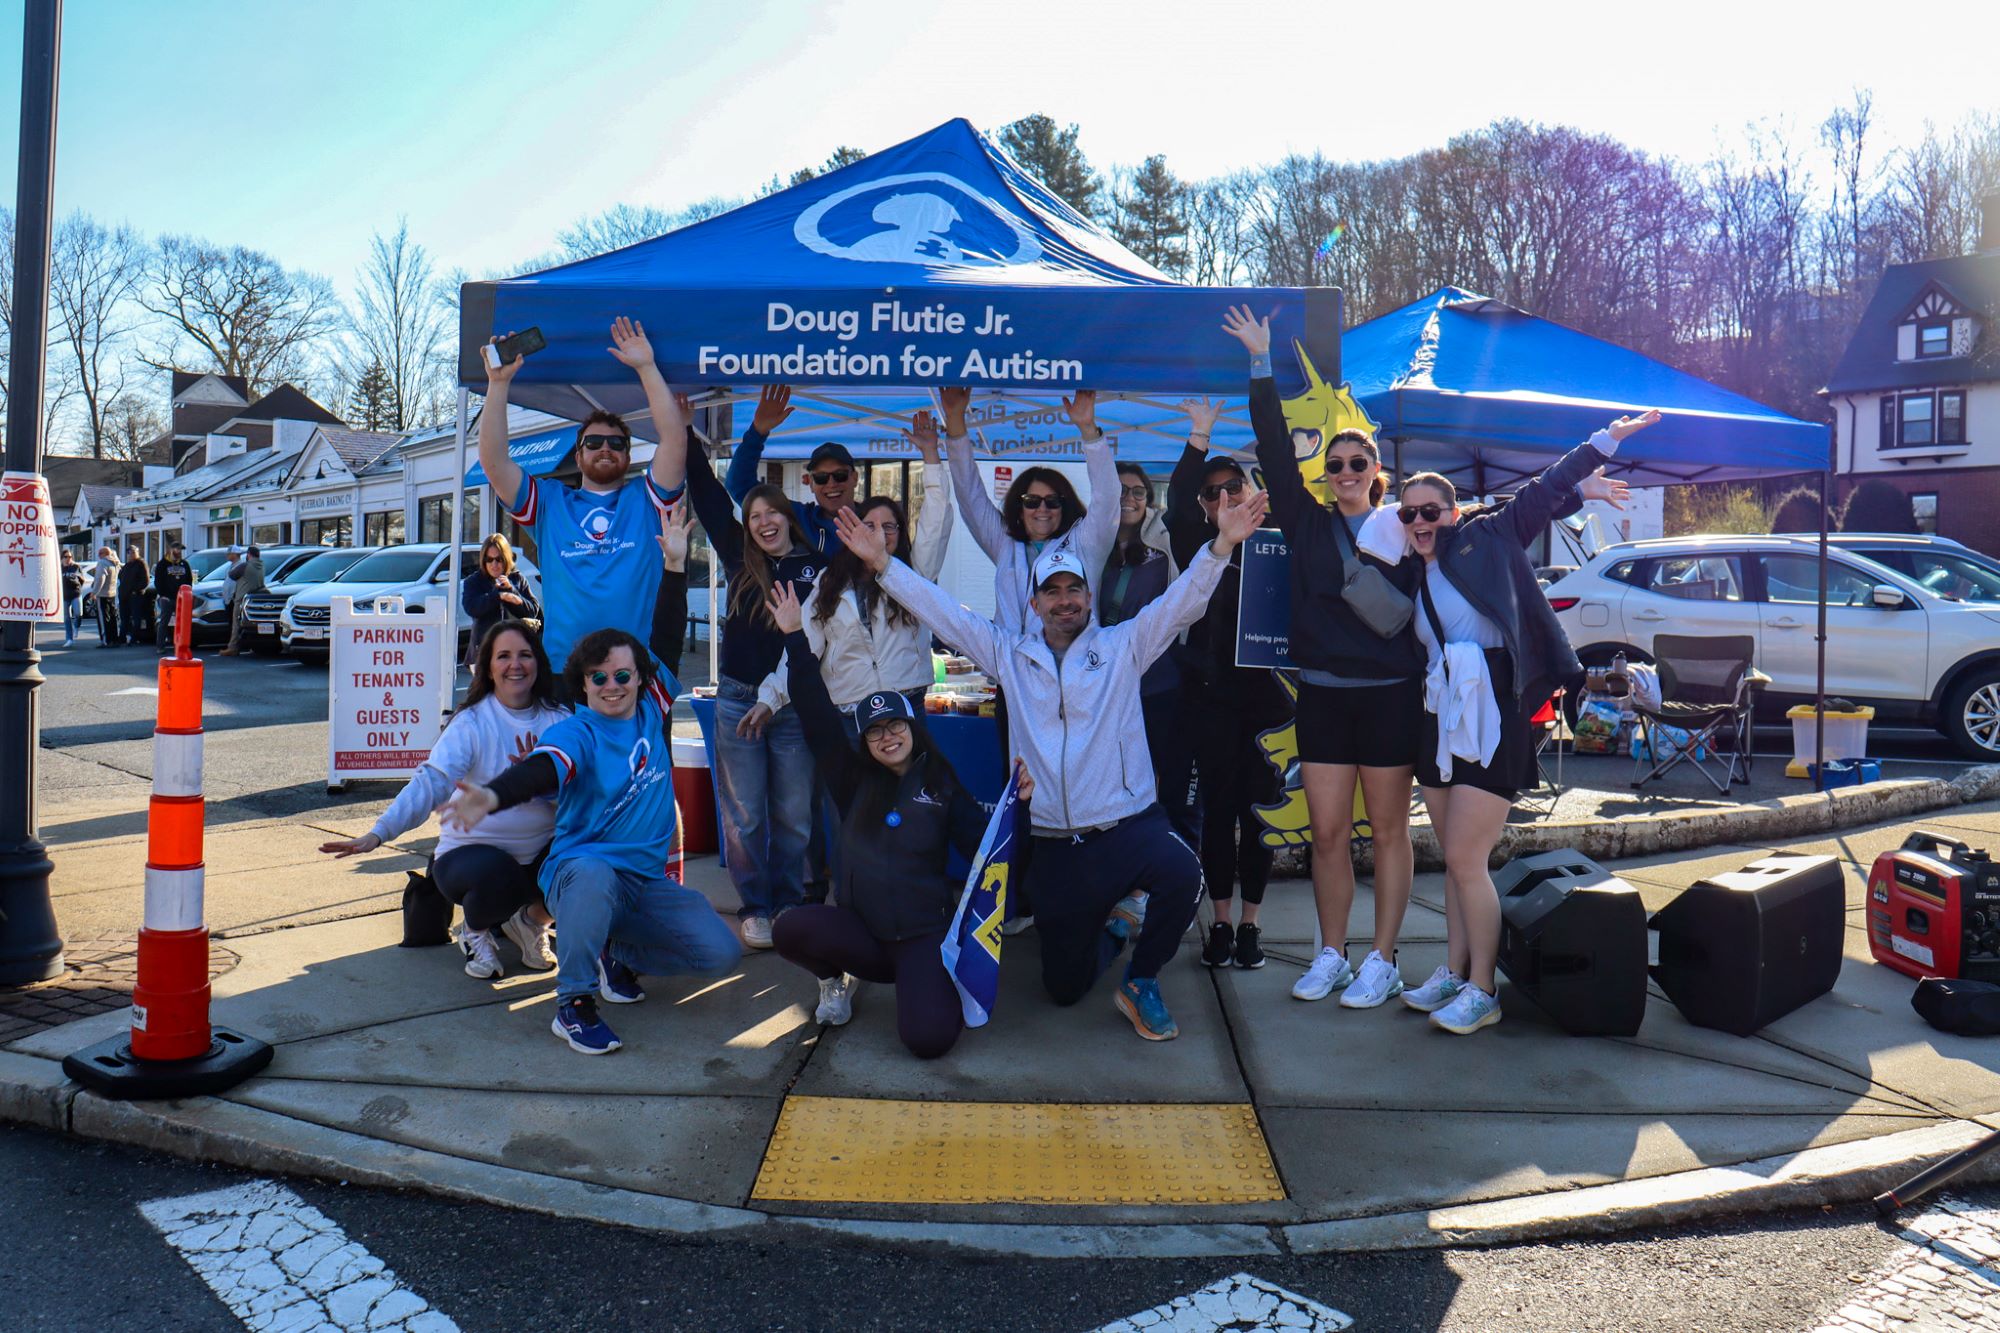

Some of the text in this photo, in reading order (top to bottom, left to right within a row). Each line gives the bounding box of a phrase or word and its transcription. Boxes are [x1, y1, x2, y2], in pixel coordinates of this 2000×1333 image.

[767, 301, 1014, 341] Doug Flutie Jr.
[699, 344, 1082, 381] Foundation for Autism
[508, 438, 560, 458] ARATHON
[8, 504, 39, 521] NO
[0, 521, 54, 538] TOPPING
[1255, 543, 1287, 556] LET'S
[0, 596, 50, 610] ONDAY
[353, 629, 424, 643] PARKING
[1244, 632, 1272, 644] Helping
[373, 651, 404, 665] FOR
[352, 673, 425, 688] TENANTS
[383, 691, 394, 707] &
[357, 709, 420, 725] GUESTS
[367, 731, 410, 747] ONLY
[354, 752, 381, 760] OTHERS
[383, 752, 399, 760] WILL
[401, 751, 411, 759] BE
[346, 760, 373, 769] VEHICLE
